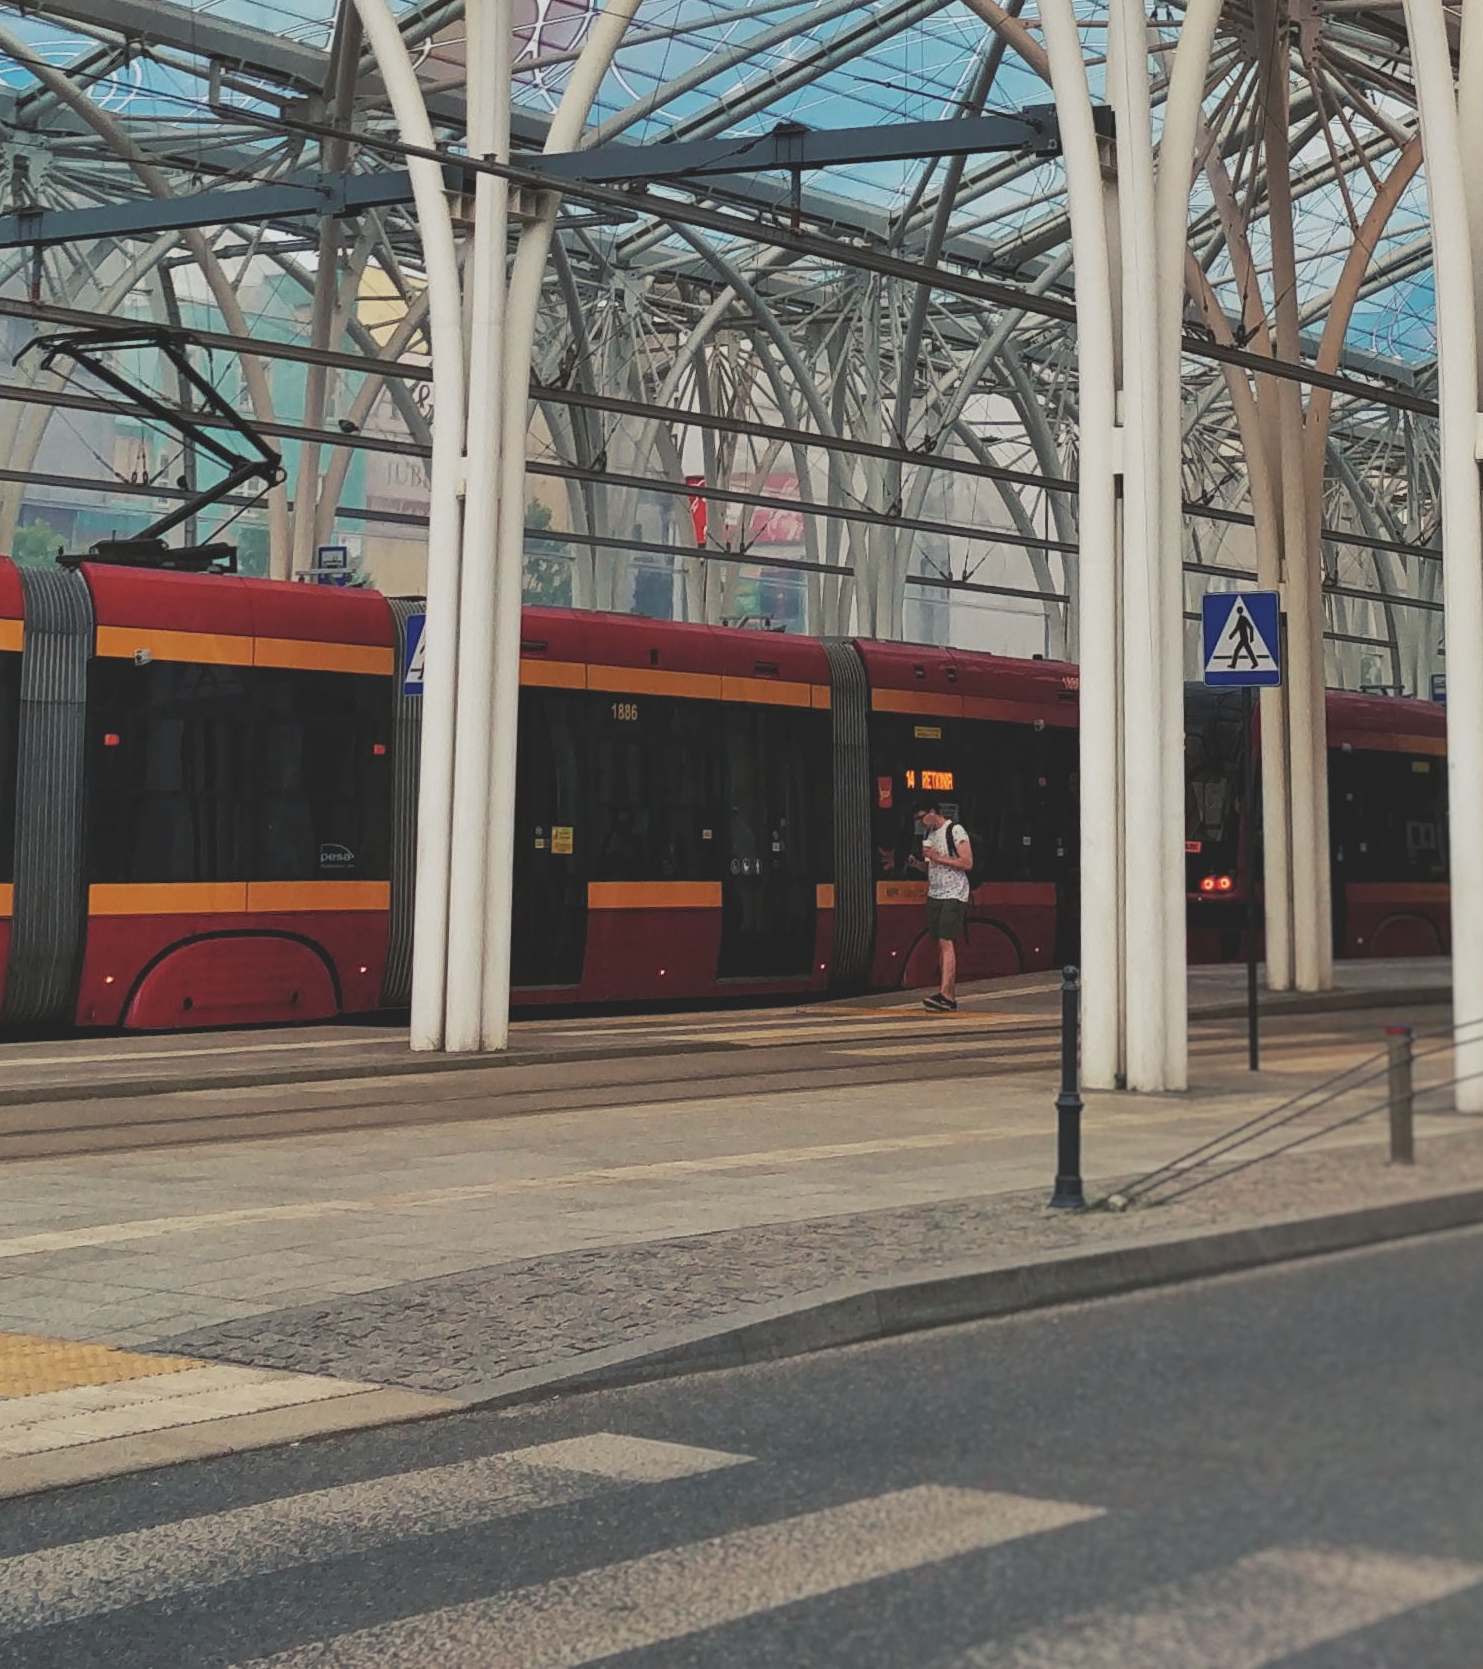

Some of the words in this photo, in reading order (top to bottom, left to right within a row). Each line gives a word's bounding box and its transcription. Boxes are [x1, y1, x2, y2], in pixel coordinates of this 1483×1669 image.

[611, 703, 638, 721] 1886
[906, 770, 915, 788] 14
[320, 852, 351, 862] pesa
